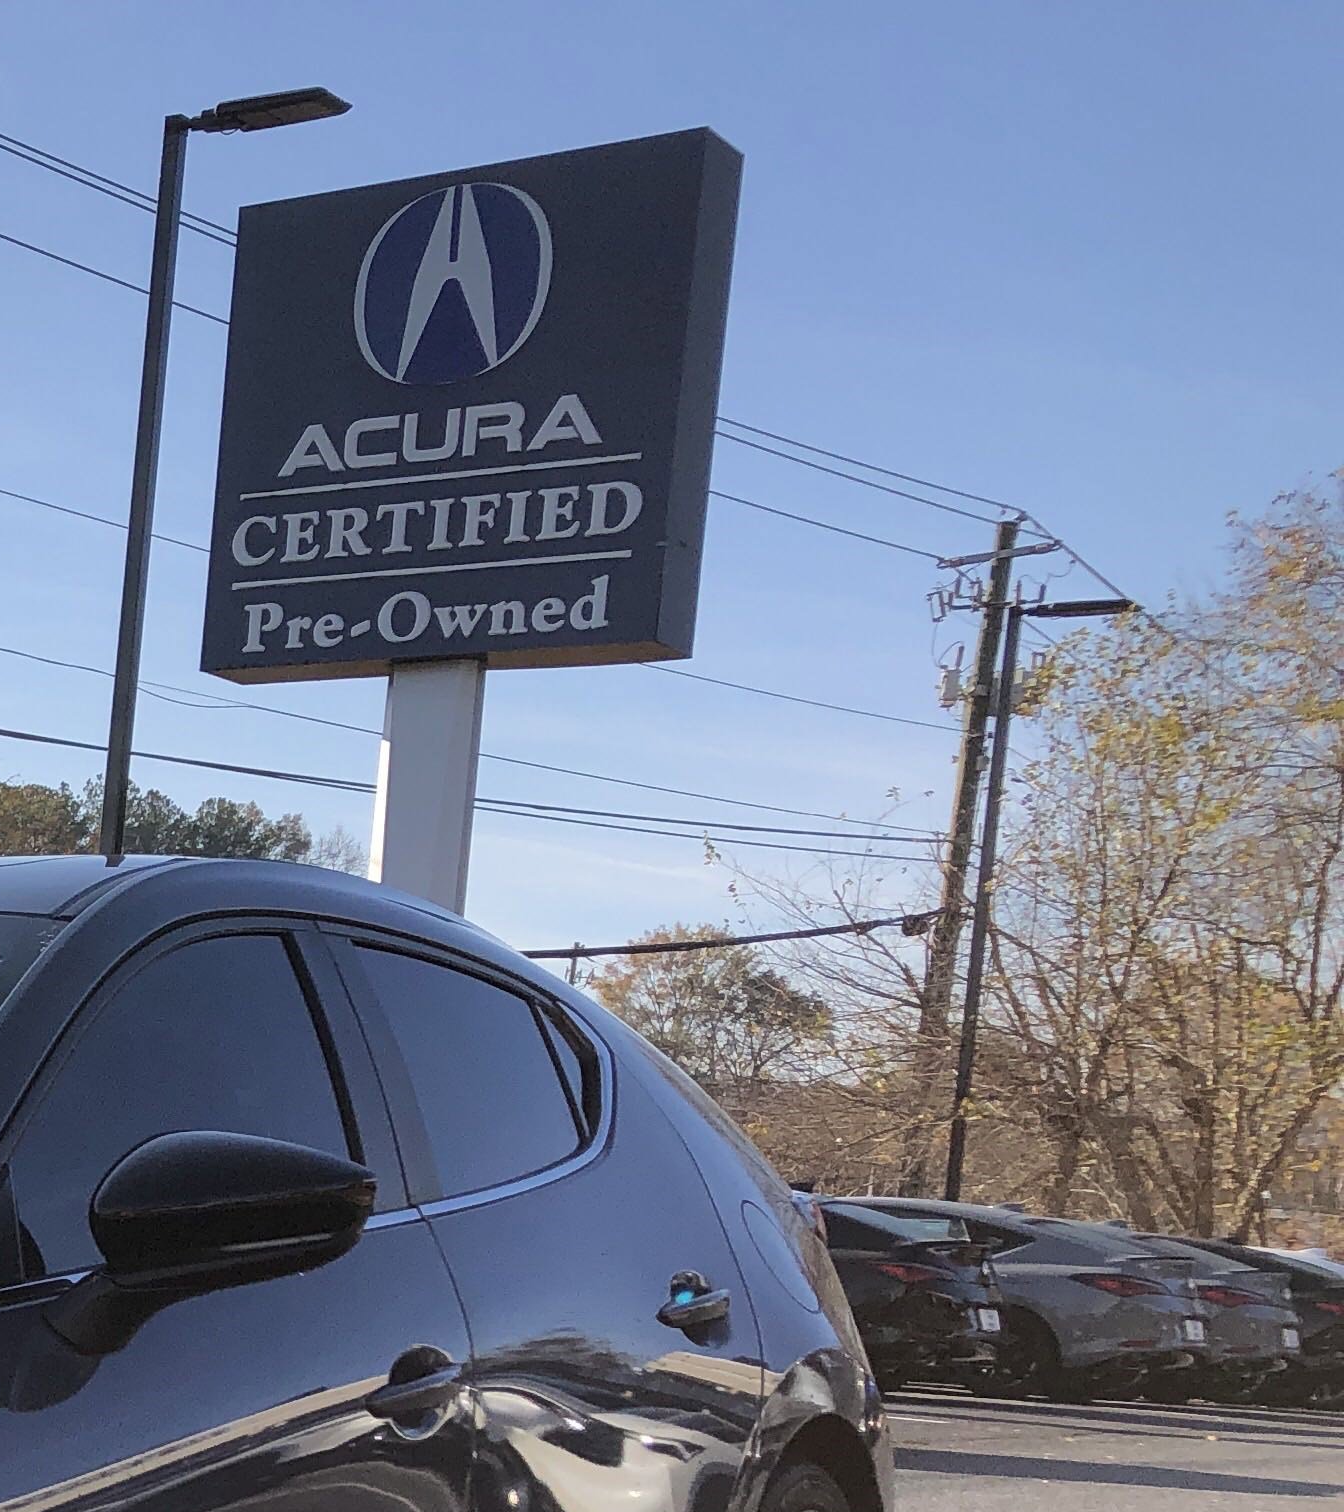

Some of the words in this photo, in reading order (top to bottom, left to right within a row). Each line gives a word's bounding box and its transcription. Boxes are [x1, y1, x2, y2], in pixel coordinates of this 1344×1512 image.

[277, 393, 603, 478] ACURA
[231, 479, 643, 568] CERTIFIED
[241, 574, 611, 655] Pre-Owned
